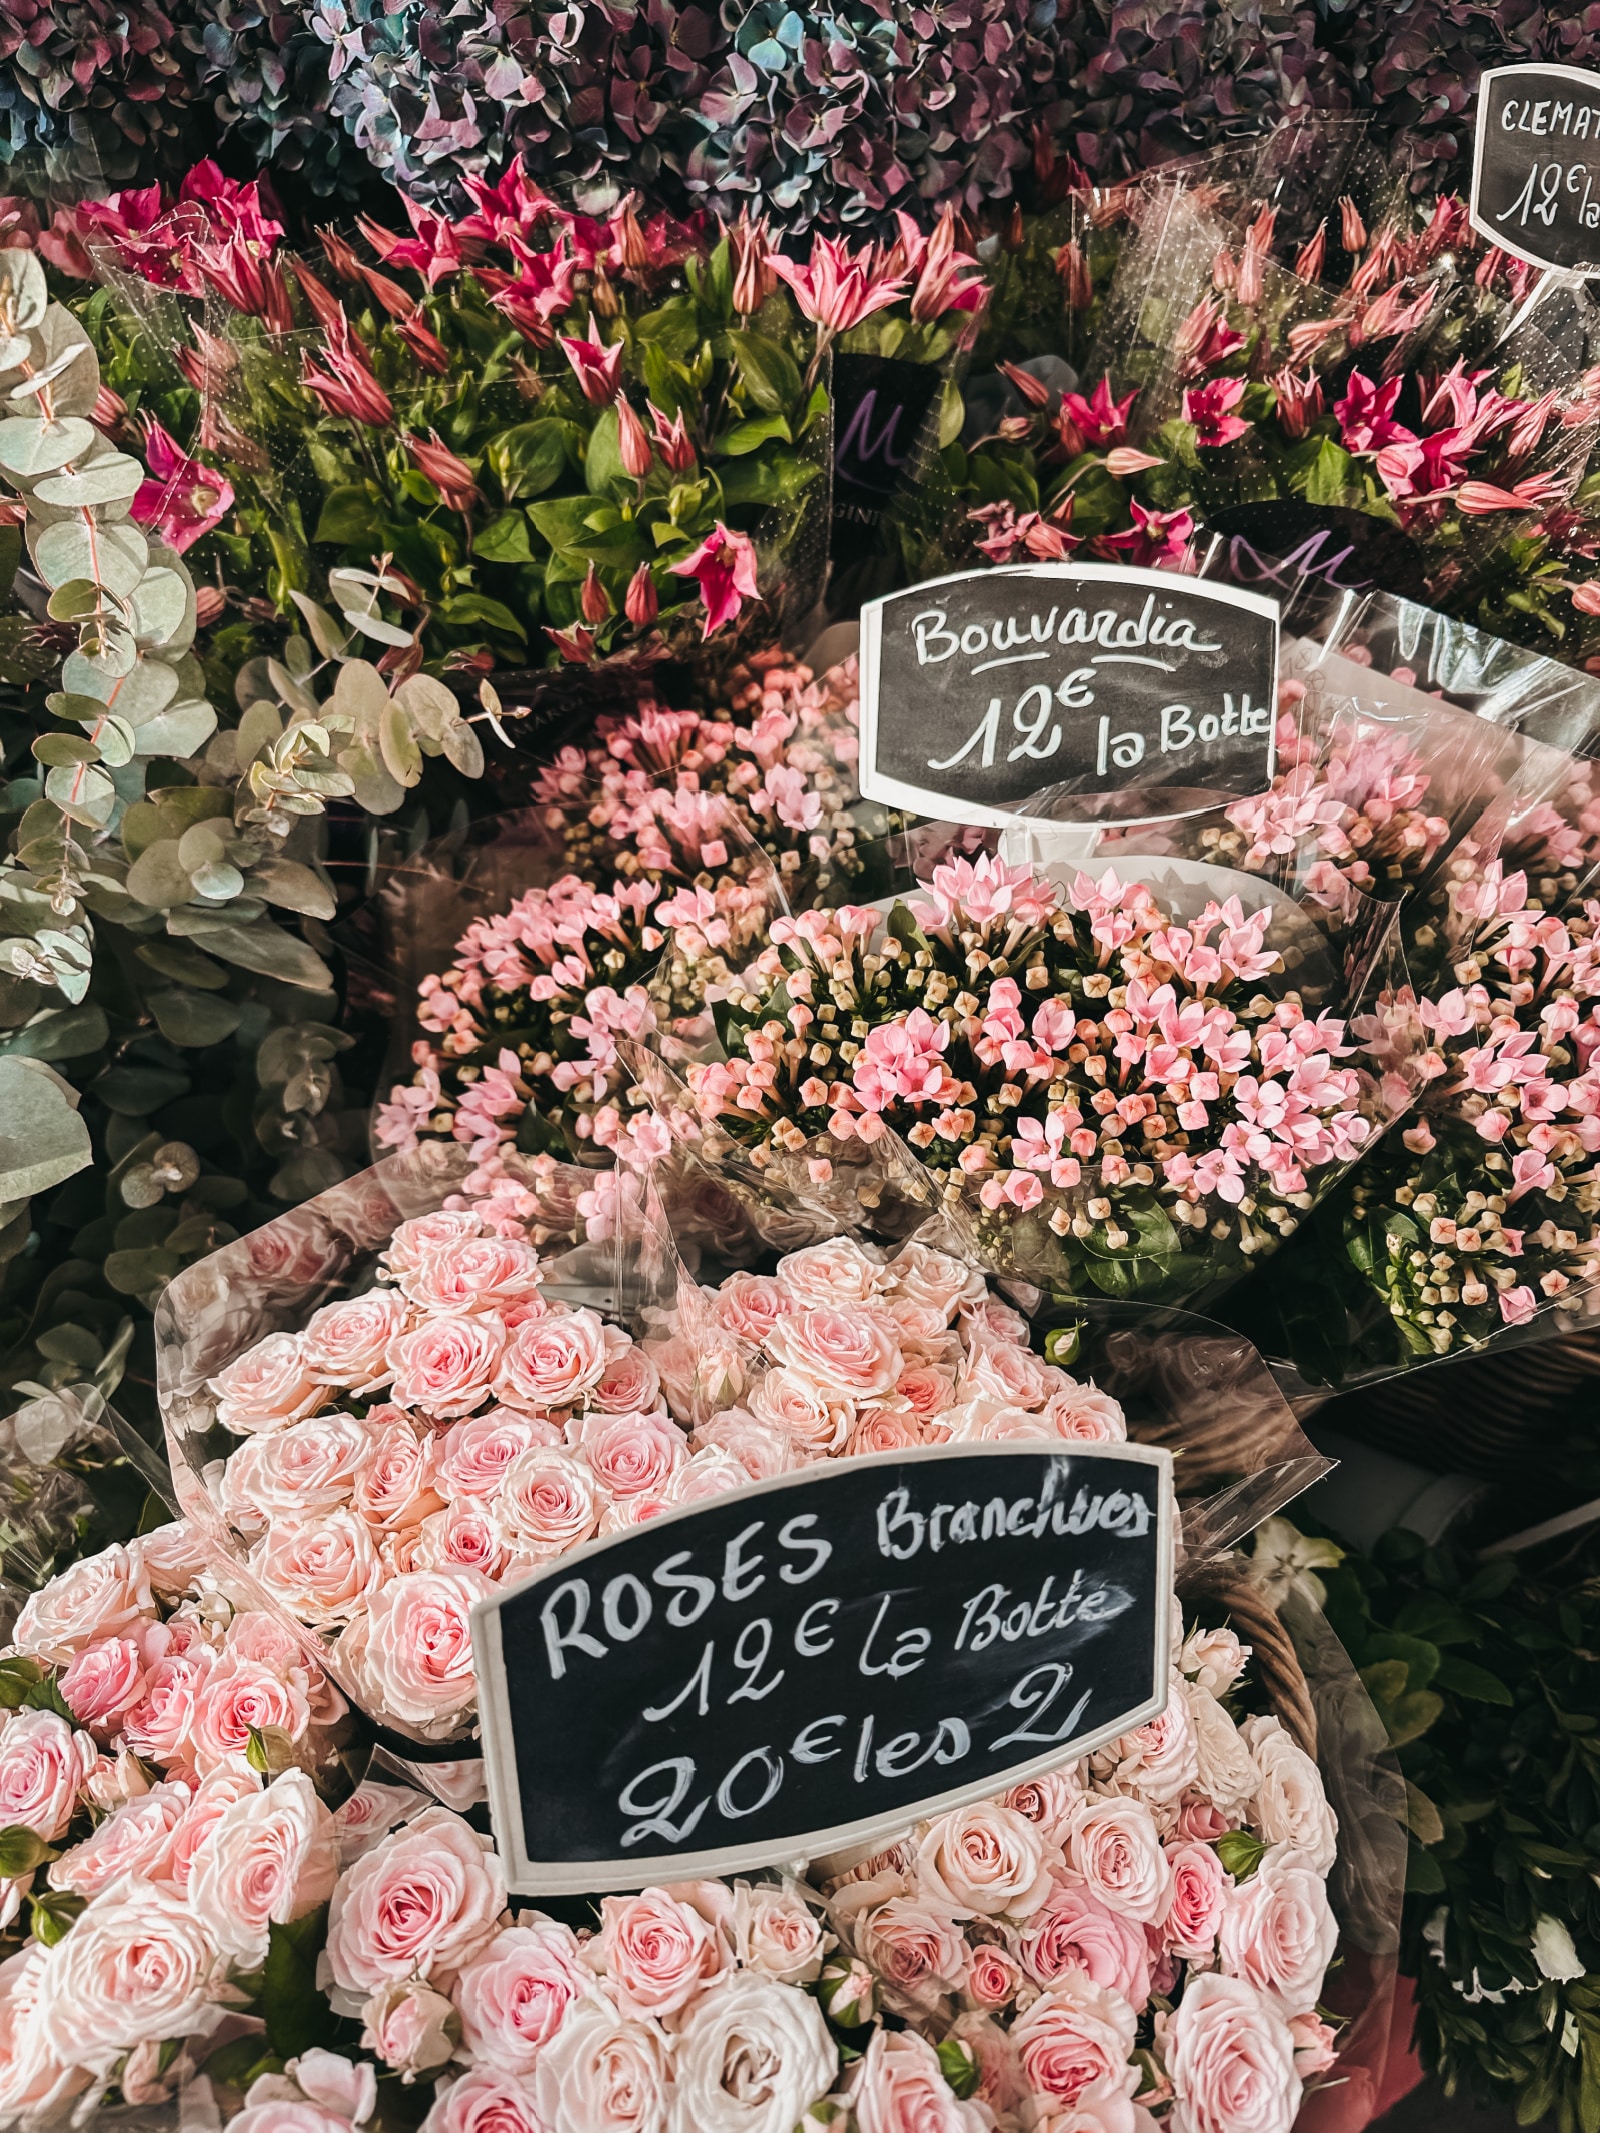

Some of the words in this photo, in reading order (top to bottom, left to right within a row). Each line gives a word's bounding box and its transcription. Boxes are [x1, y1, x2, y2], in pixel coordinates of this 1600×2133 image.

[1495, 162, 1587, 227] 12€
[911, 594, 1222, 666] Bouvardia
[927, 668, 1098, 770] 12€
[1097, 715, 1145, 777] la
[540, 1513, 833, 1680] ROSES
[642, 1598, 841, 1722] 12€
[618, 1714, 848, 1848] 20€
[853, 1714, 971, 1783] les
[988, 1662, 1093, 1751] 2
